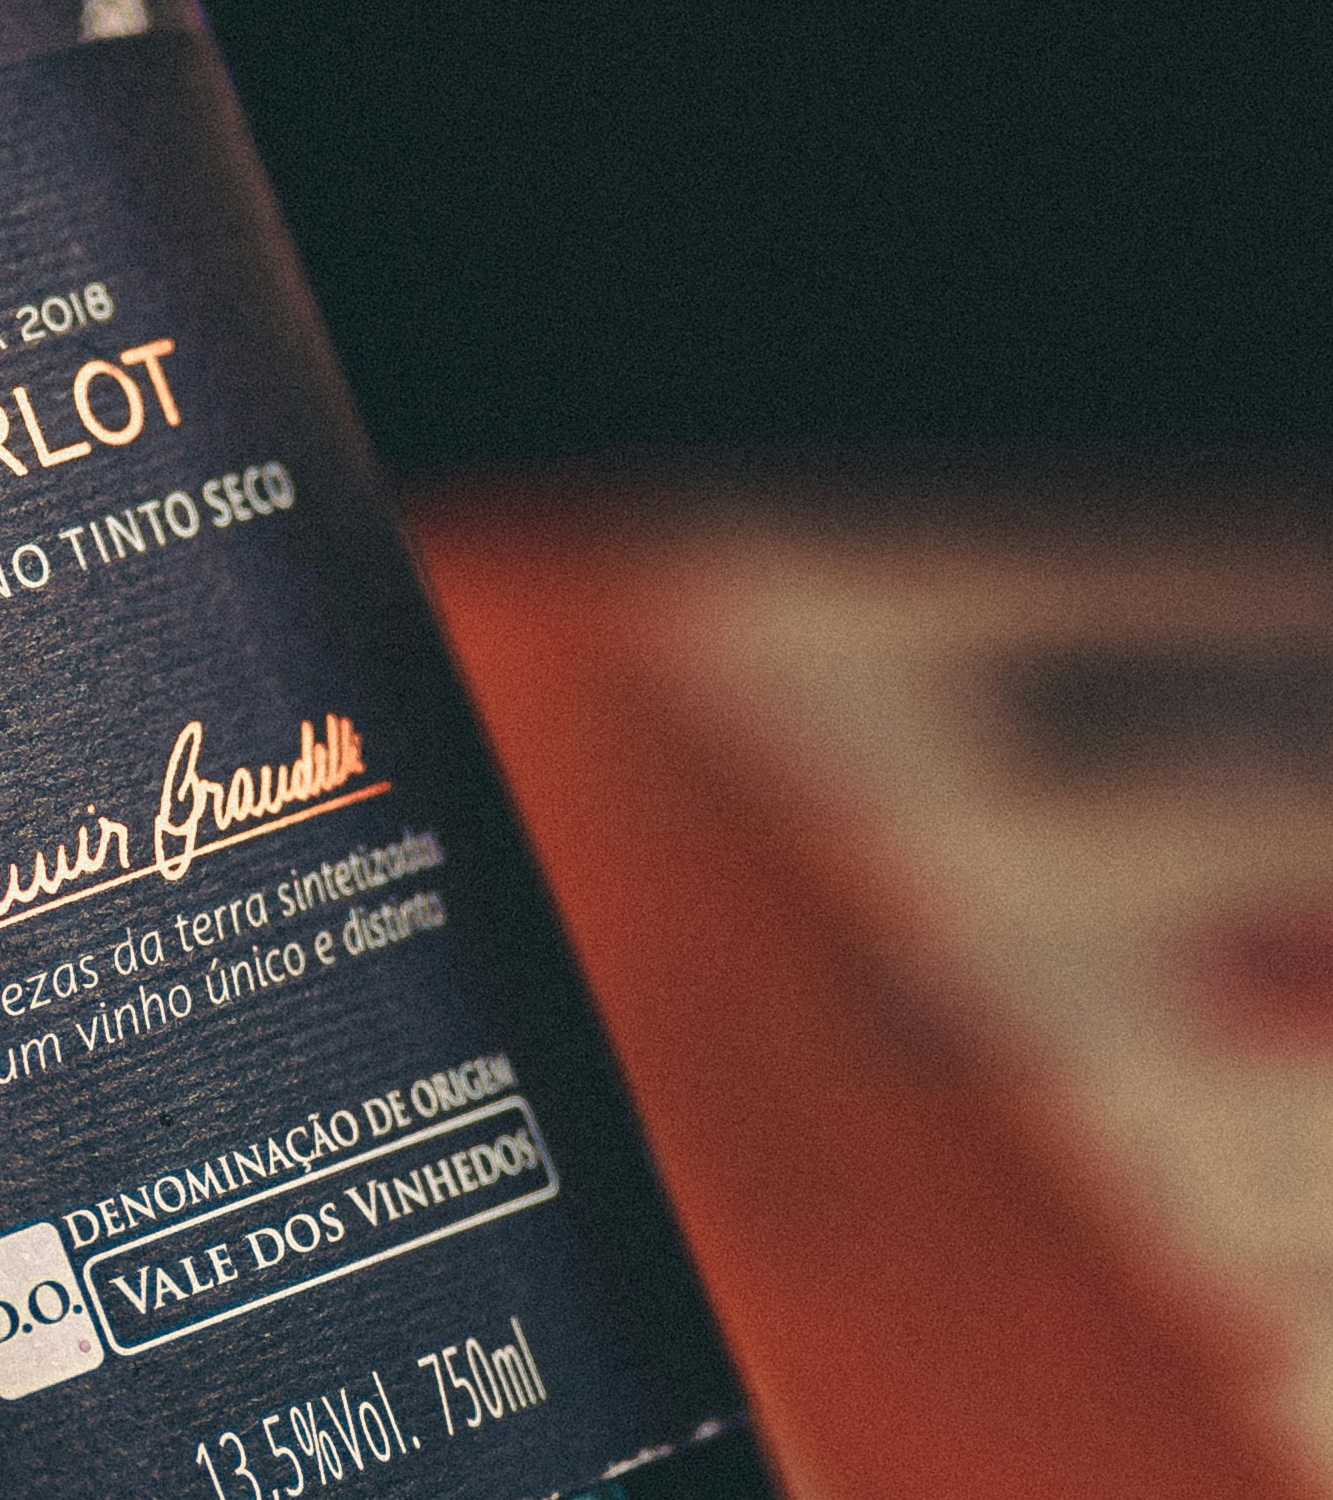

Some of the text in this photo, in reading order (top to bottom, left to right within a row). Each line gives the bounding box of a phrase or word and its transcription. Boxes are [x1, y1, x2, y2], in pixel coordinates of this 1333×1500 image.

[17, 282, 114, 343] 2018
[59, 491, 200, 571] TINTO
[203, 461, 296, 528] SECO
[75, 980, 192, 1052] vinho
[206, 940, 307, 1006] único
[314, 930, 337, 967] e
[342, 891, 446, 957] distinto
[114, 927, 166, 975] da
[174, 890, 269, 948] terra
[63, 1053, 519, 1250] DENOMINAÇÃO DE ORIGEM
[109, 1129, 537, 1316] VALE DOS VINHEDOS
[416, 1315, 547, 1436] 750ml
